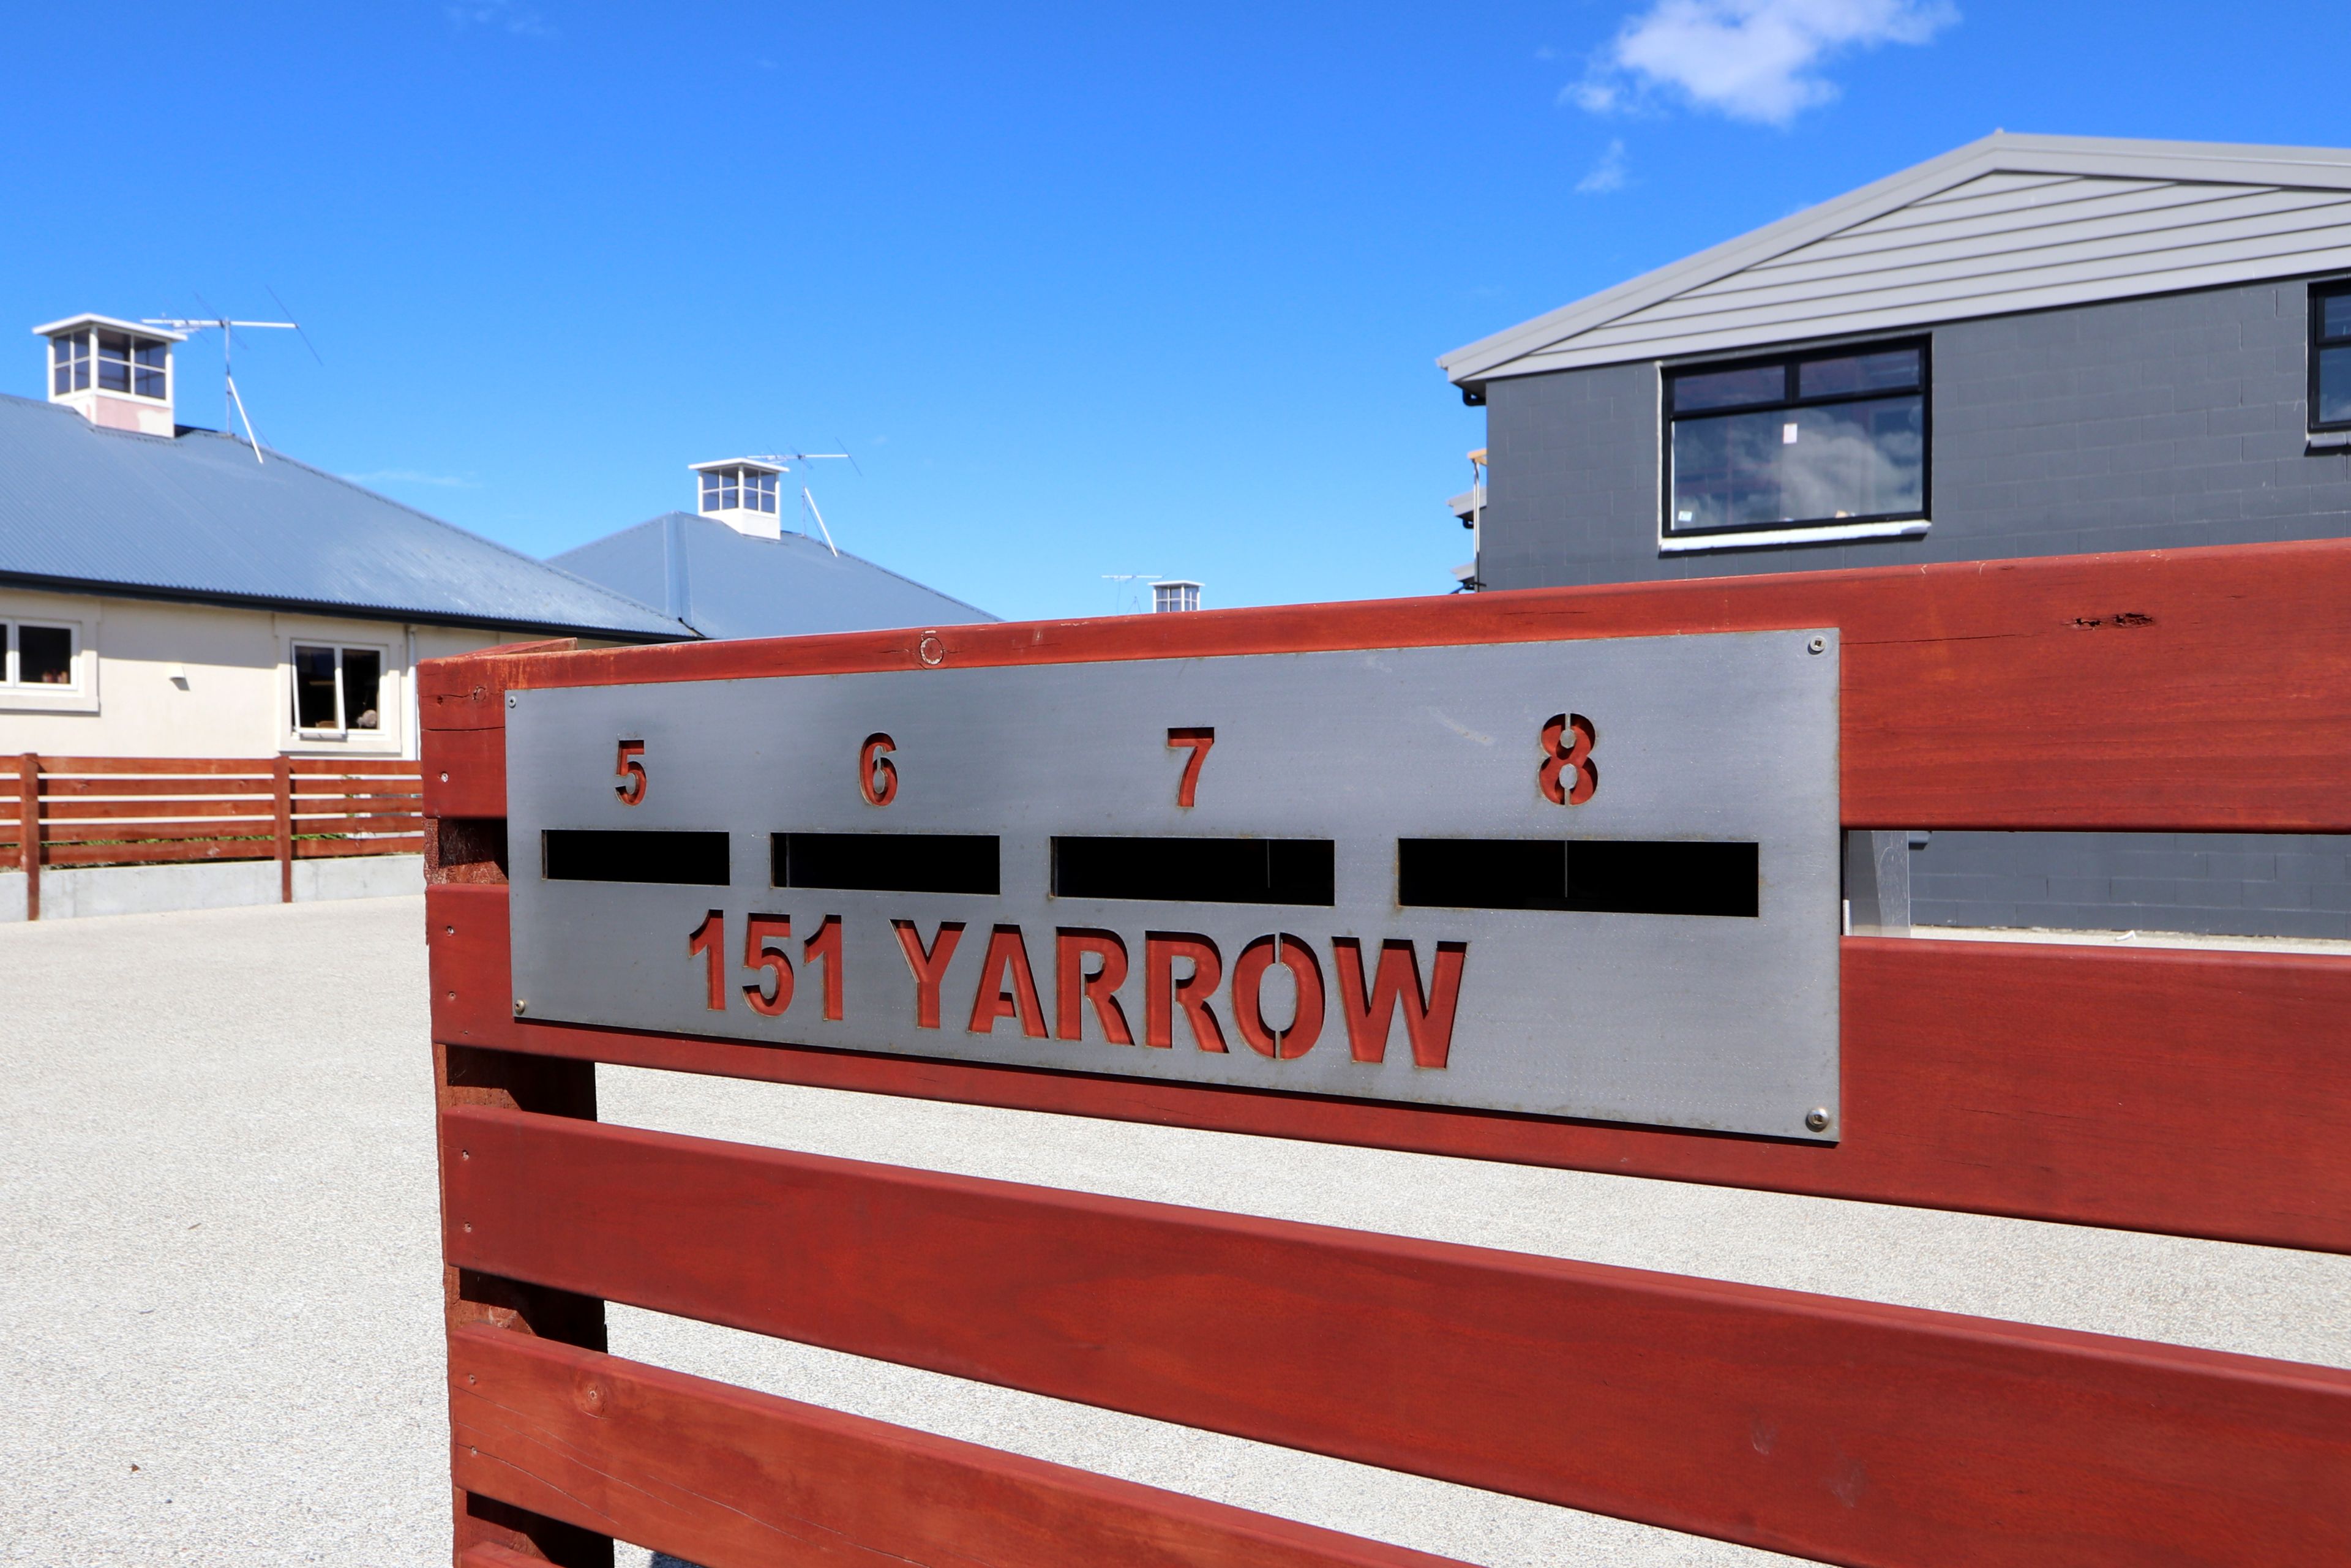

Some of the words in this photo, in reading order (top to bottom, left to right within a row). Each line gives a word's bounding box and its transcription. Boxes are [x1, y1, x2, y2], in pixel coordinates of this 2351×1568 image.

[615, 739, 647, 806] 5
[858, 732, 898, 807] 6
[1167, 727, 1215, 808] 7
[1539, 713, 1599, 805] 8
[688, 909, 844, 1021] 151
[891, 919, 1468, 1069] YARROW
